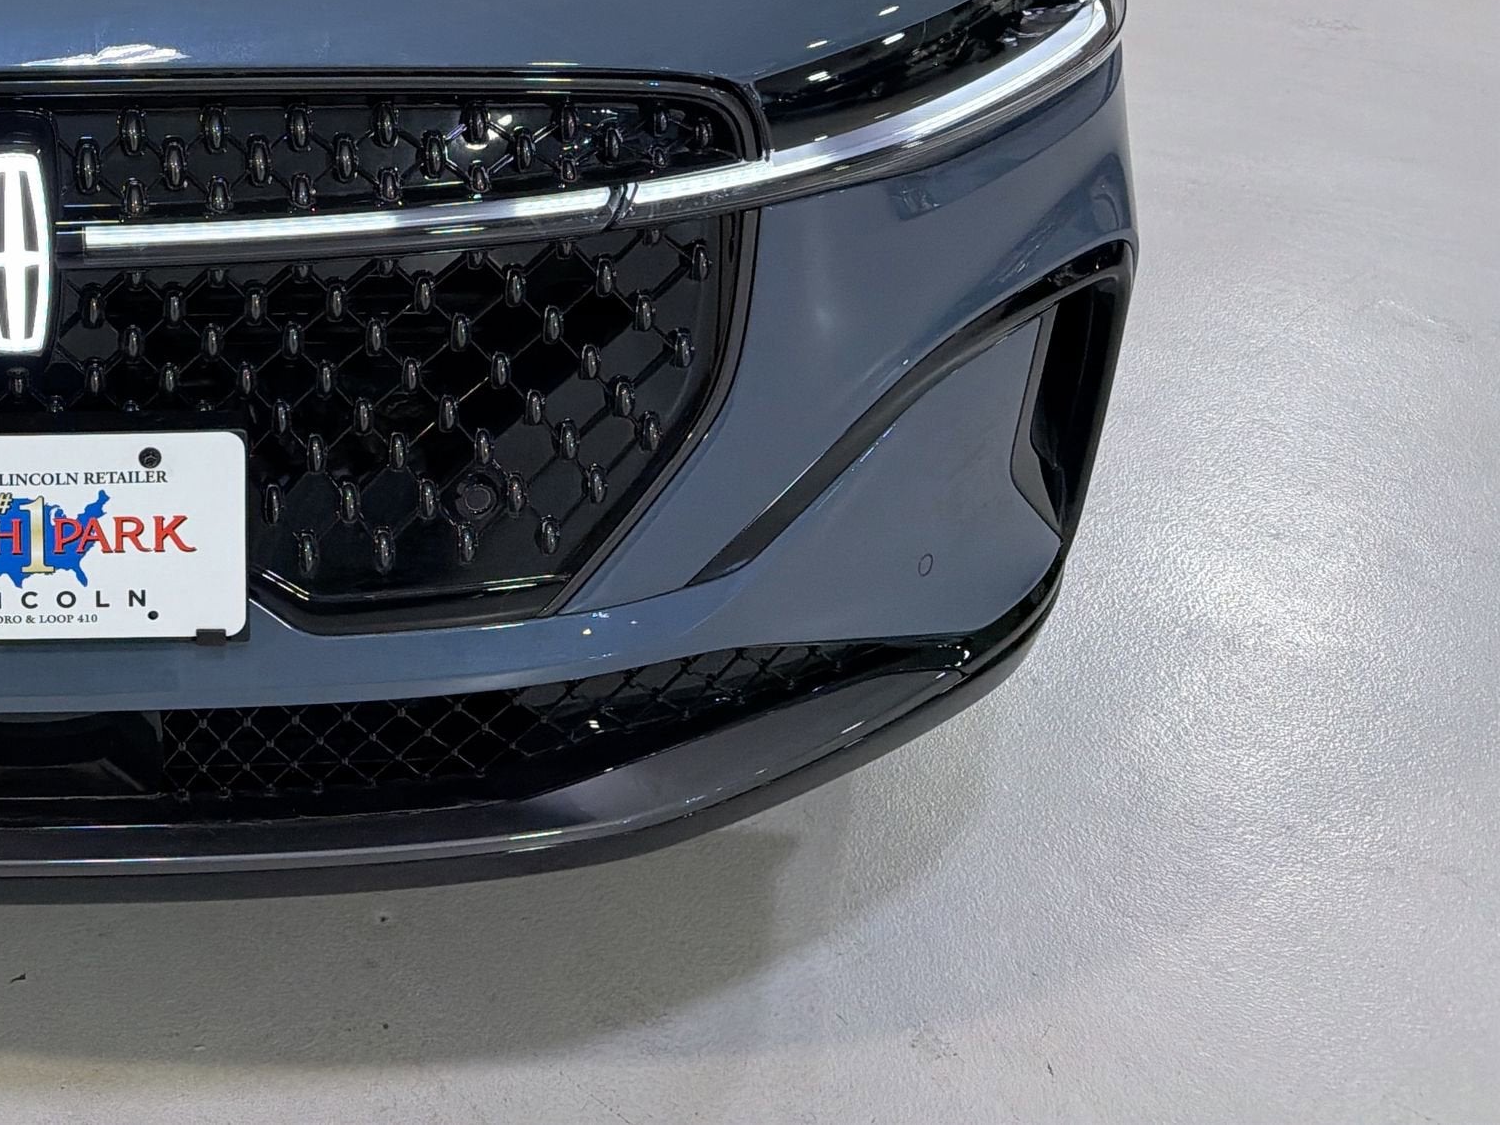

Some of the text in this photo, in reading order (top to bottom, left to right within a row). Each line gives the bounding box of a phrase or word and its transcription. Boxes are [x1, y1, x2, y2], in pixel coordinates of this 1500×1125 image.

[83, 470, 168, 485] RETAILER
[52, 515, 198, 555] PARK
[25, 615, 35, 625] &
[39, 615, 74, 624] LOOP
[77, 614, 98, 623] 410
